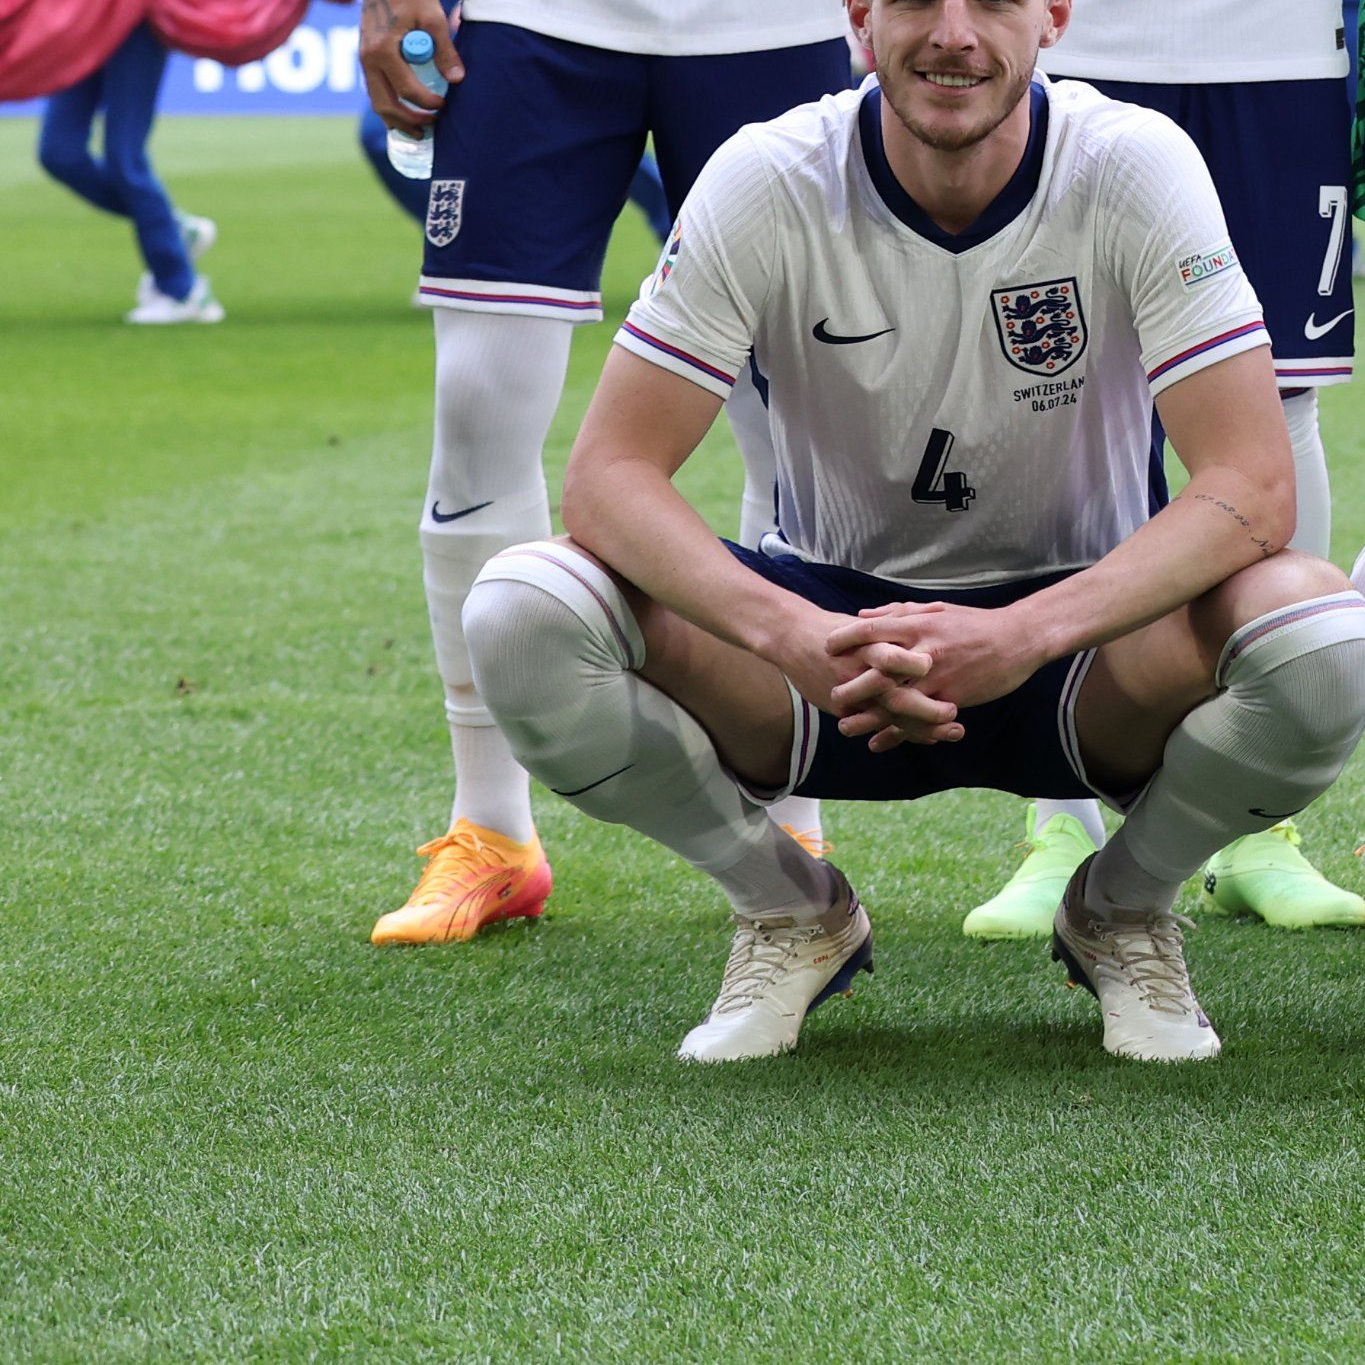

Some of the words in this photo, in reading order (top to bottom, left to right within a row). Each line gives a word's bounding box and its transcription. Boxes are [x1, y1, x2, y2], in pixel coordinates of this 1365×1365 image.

[1317, 185, 1348, 296] 7
[1179, 254, 1202, 269] UEFA
[1181, 248, 1235, 281] FOUNDA
[1013, 376, 1085, 402] SWITZERLAN
[1031, 393, 1077, 412] 06.07.24
[911, 428, 976, 512] 4
